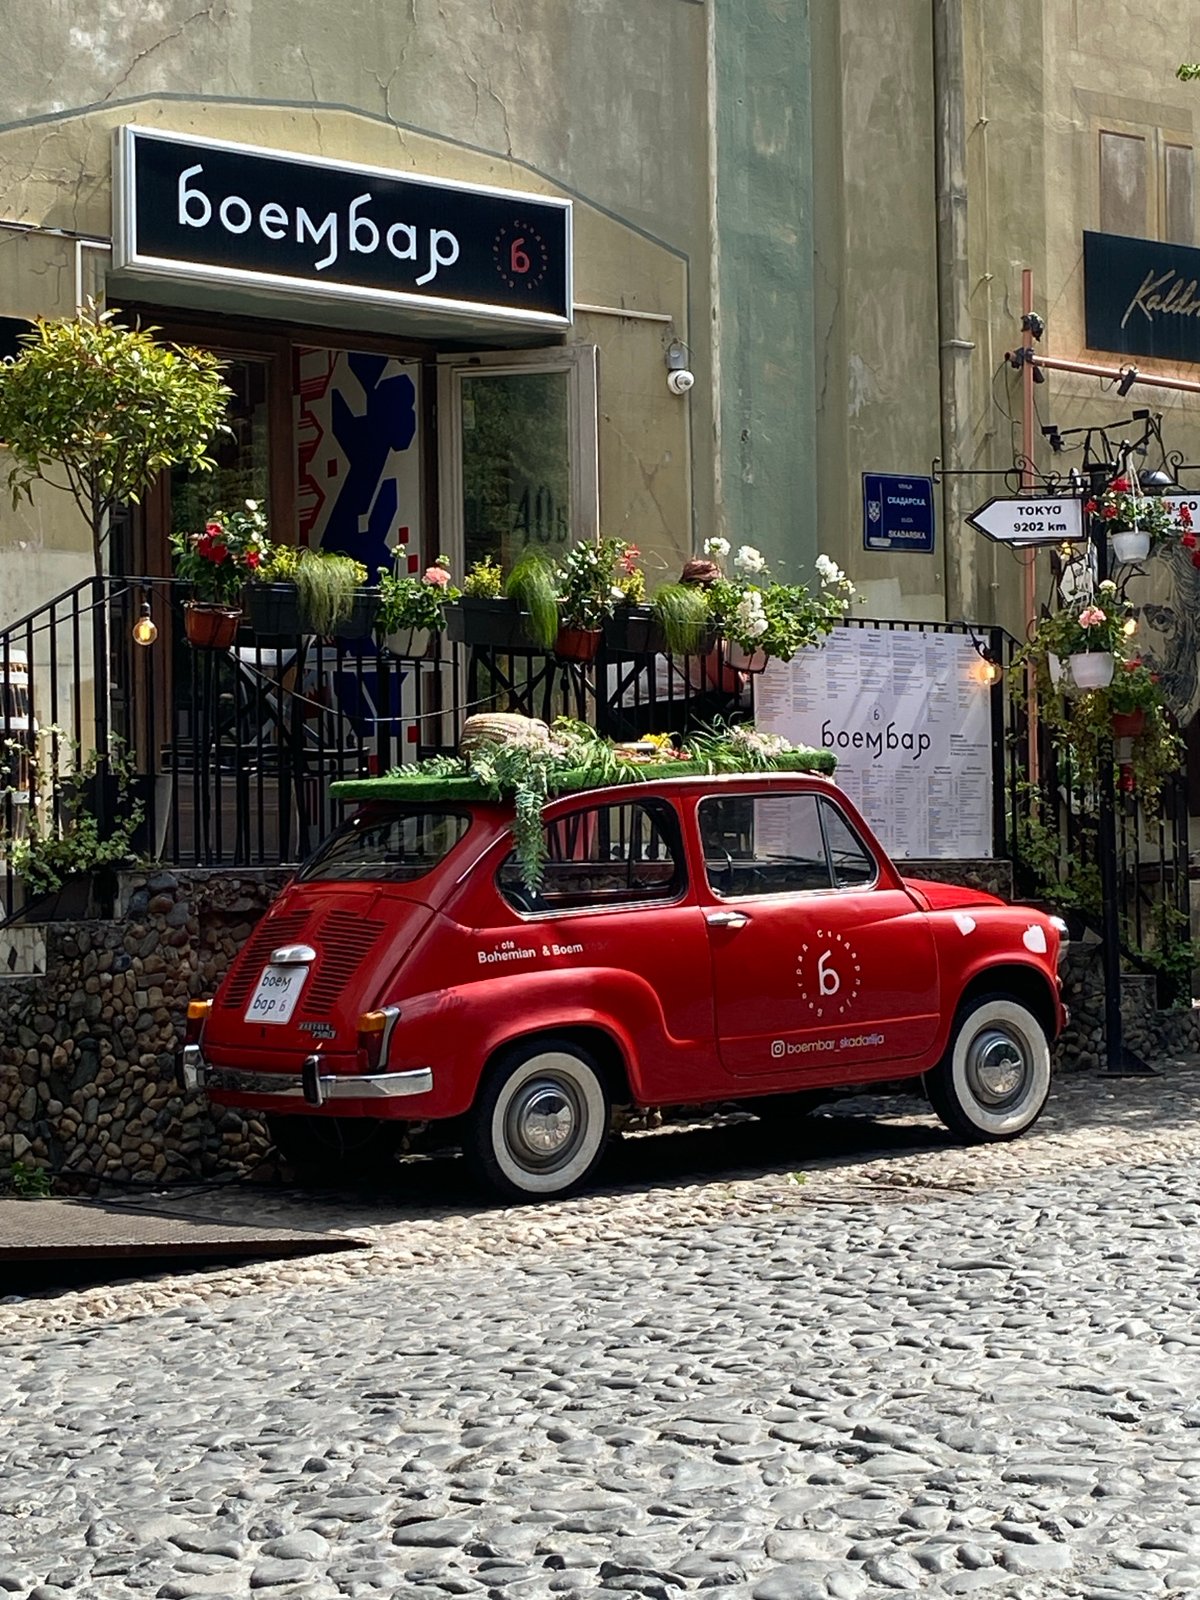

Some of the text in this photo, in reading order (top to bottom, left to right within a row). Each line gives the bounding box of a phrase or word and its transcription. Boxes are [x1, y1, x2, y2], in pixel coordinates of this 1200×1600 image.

[178, 164, 460, 286] боембар
[1017, 505, 1062, 516] TOKYO
[1013, 522, 1067, 532] 9202 km
[822, 719, 931, 760] боембар
[477, 948, 537, 964] Bohemian
[542, 945, 551, 956] &
[552, 943, 584, 956] Boem
